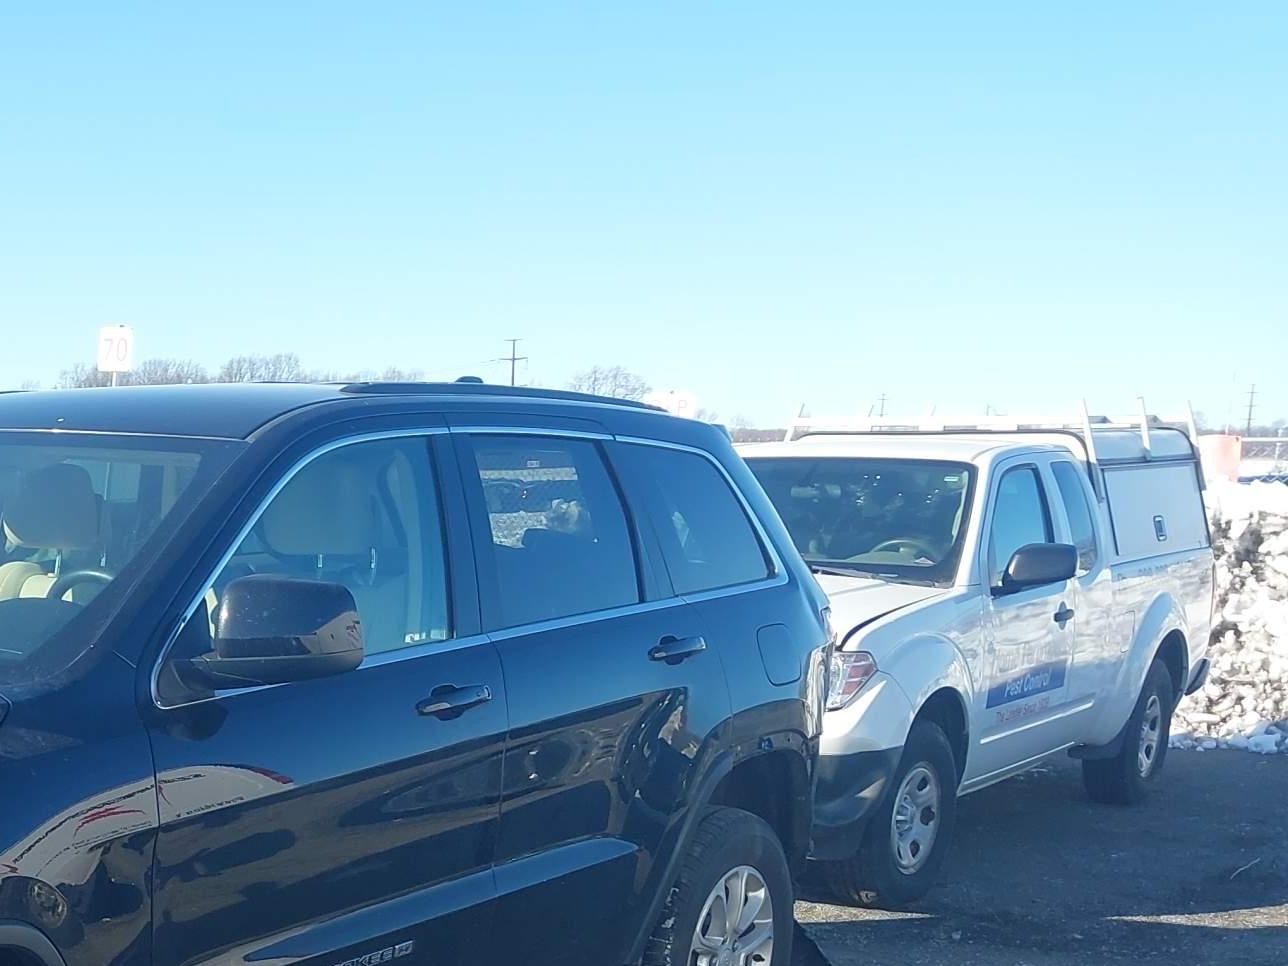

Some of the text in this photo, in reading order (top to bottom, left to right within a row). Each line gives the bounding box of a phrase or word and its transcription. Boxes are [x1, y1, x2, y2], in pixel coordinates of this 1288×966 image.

[103, 337, 128, 362] 70
[1004, 668, 1051, 698] Pest Control
